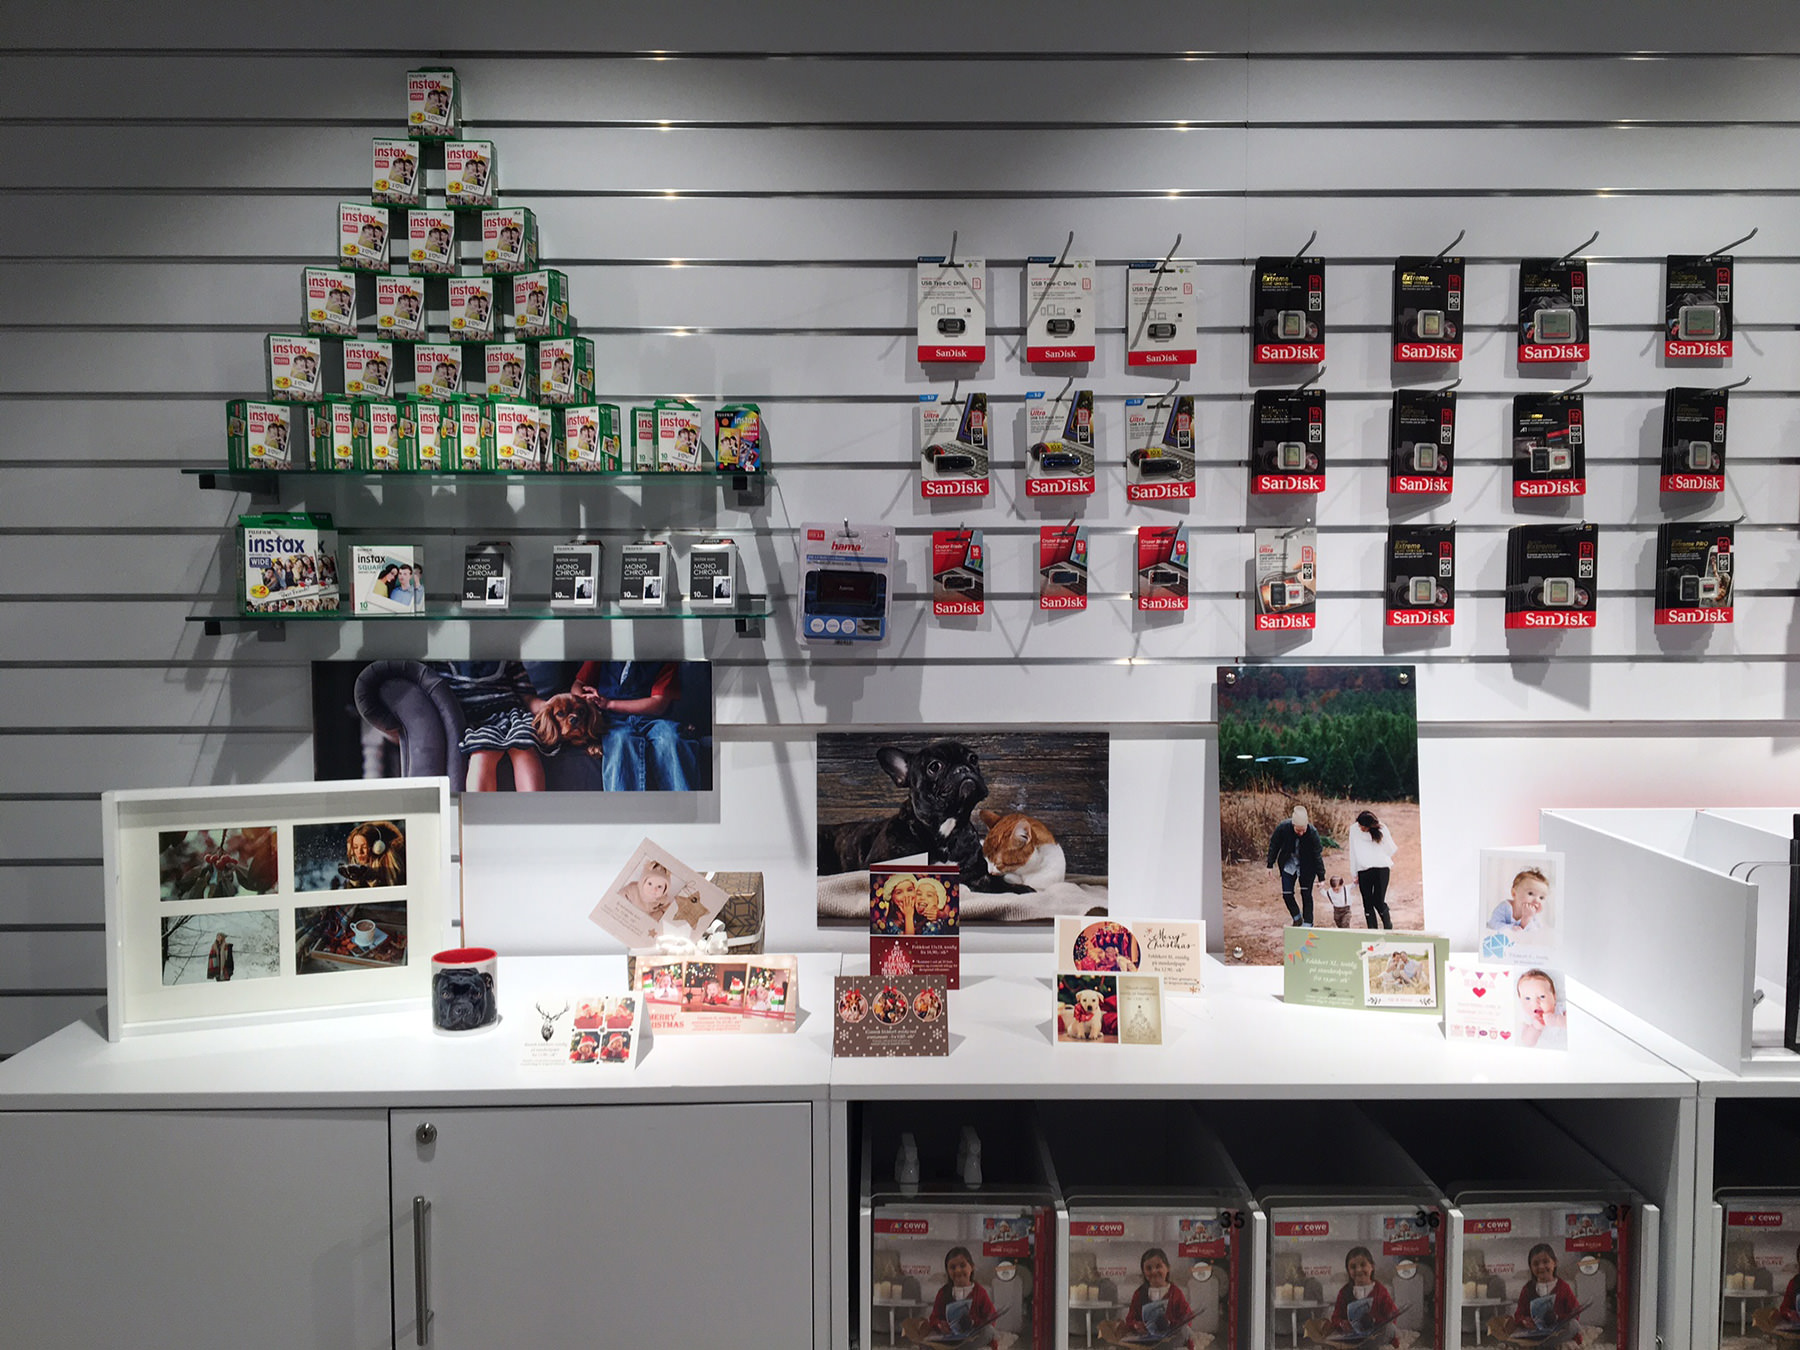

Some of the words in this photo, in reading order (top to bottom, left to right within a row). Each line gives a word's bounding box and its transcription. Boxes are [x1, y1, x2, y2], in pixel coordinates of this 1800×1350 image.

[409, 79, 441, 89] instax
[374, 147, 407, 157] instax
[447, 149, 479, 159] instax
[343, 212, 376, 224] instax
[410, 217, 442, 227] instax
[484, 217, 513, 227] instax
[309, 277, 343, 289] instax
[379, 282, 411, 294] instax
[514, 281, 539, 292] instax
[450, 283, 480, 295] instax
[272, 343, 307, 354] instax
[346, 348, 380, 359] instax
[541, 348, 565, 358] instax
[936, 349, 967, 357] SanDisk
[1045, 350, 1077, 358] SanDisk
[1261, 346, 1319, 359] SanDisk
[1402, 345, 1457, 358] SanDisk
[1525, 346, 1584, 359] SanDisk
[1669, 342, 1726, 355] SanDisk
[417, 352, 450, 362] instax
[487, 352, 515, 362] instax
[1146, 354, 1178, 362] SanDisk
[249, 411, 279, 423] instax
[335, 411, 351, 422] ins
[373, 412, 397, 423] insta
[462, 413, 479, 423] inst
[498, 413, 528, 423] instax
[567, 415, 590, 426] instax
[734, 416, 757, 424] instax
[923, 411, 940, 419] Ultra
[638, 417, 653, 428] ins
[660, 414, 691, 428] instax
[926, 481, 984, 495] SanDisk
[1031, 480, 1089, 493] SanDisk
[1261, 477, 1320, 490] SanDisk
[1400, 478, 1449, 491] SanDisk
[1520, 481, 1580, 495] SanDisk
[1676, 476, 1720, 490] SanDisk
[1131, 484, 1190, 498] SanDisk
[249, 534, 305, 553] instax
[831, 541, 861, 551] hama
[1395, 542, 1421, 550] Extreme
[357, 554, 386, 563] instax
[935, 602, 980, 614] SanDisk
[1041, 597, 1084, 608] SanDisk
[1141, 598, 1185, 610] SanDisk
[1393, 611, 1449, 624] SanDisk
[1525, 613, 1589, 625] SanDisk
[1669, 609, 1729, 622] SanDisk
[1260, 615, 1311, 628] SanDisk
[1153, 928, 1180, 943] Merry
[1147, 939, 1190, 949] Christmas
[1221, 1211, 1245, 1229] 35
[1415, 1211, 1440, 1228] 36
